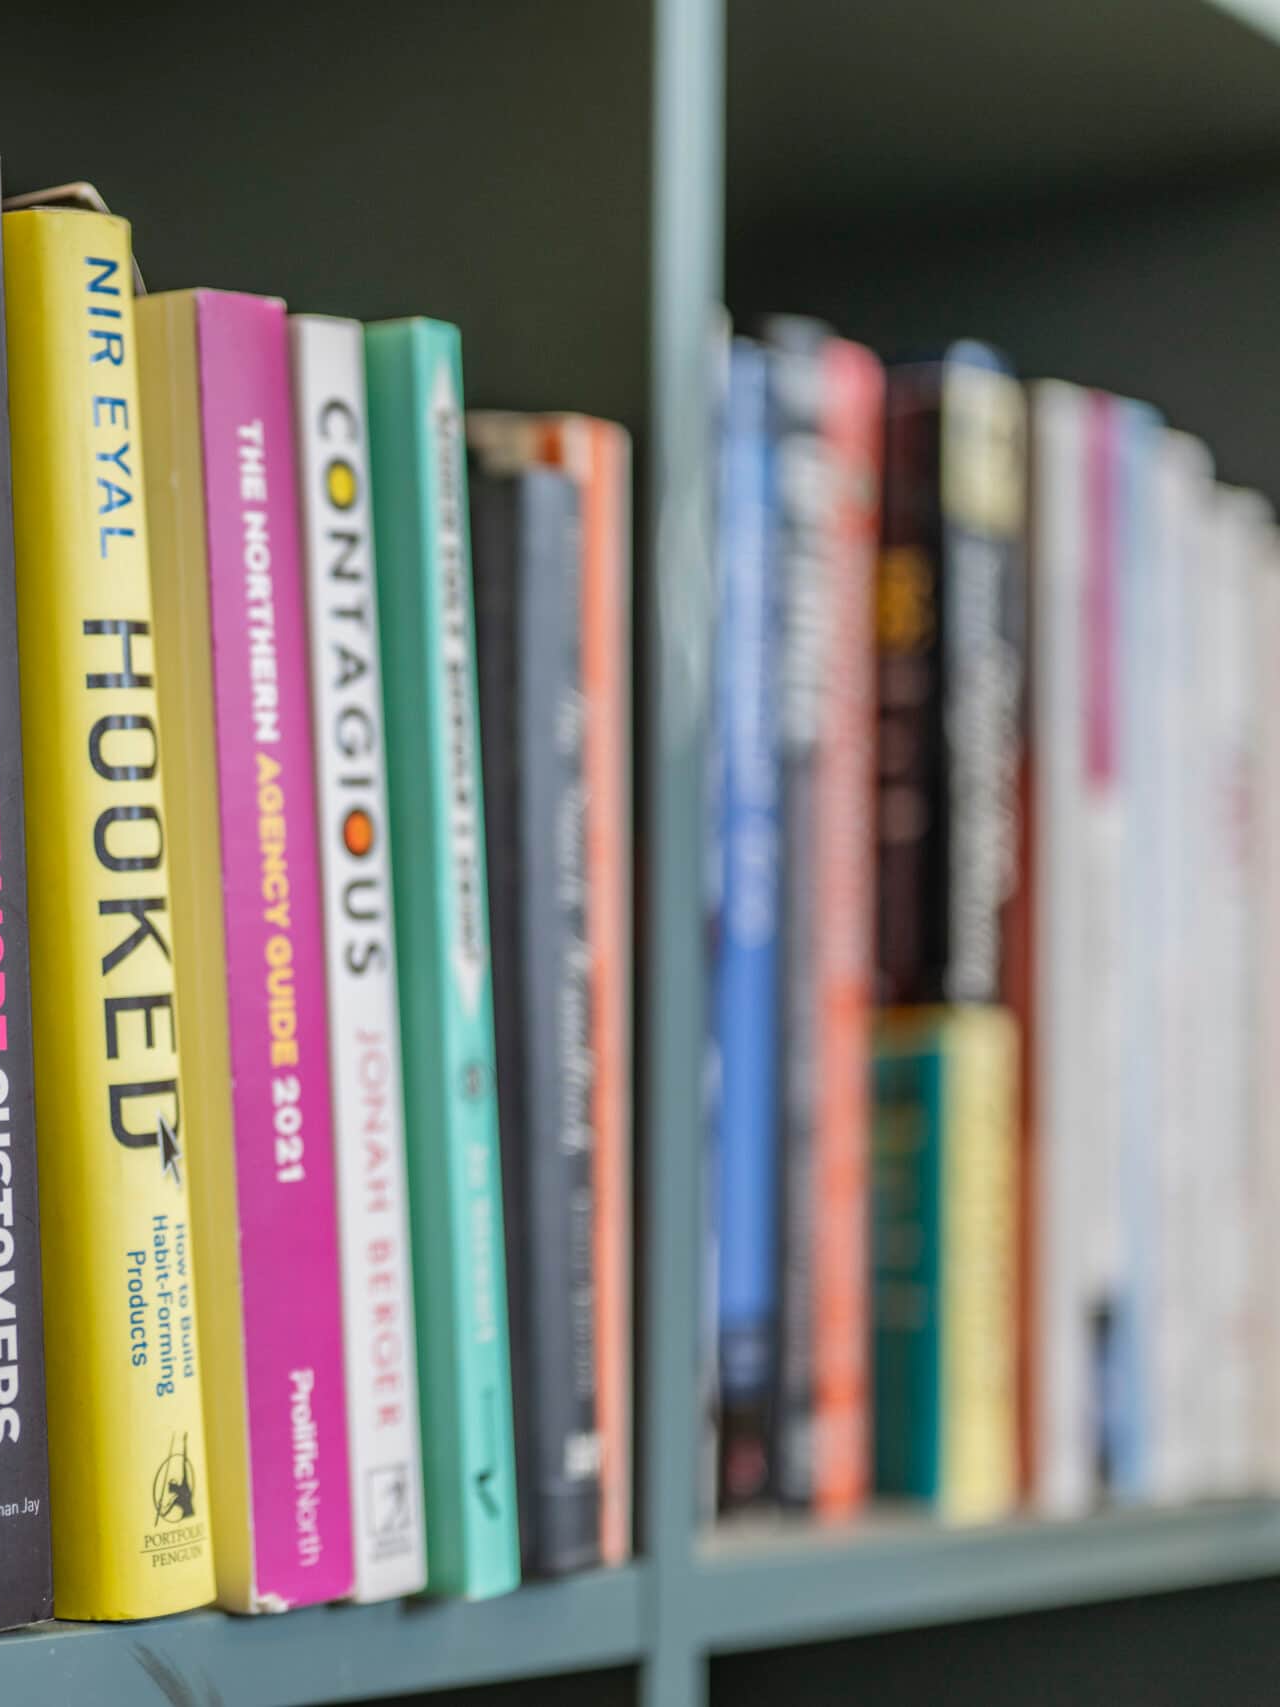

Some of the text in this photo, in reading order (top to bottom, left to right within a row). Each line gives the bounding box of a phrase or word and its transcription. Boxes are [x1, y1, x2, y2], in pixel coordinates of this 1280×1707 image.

[84, 256, 135, 560] NIR EYAL
[238, 419, 305, 1183] THE NORTHERN AGENCY GUIDE 2021
[320, 402, 384, 976] CONTAGIOUS
[83, 619, 181, 1150] HOOKED
[126, 1250, 149, 1367] Products
[152, 1215, 176, 1398] Habit-Forming
[175, 1223, 194, 1379] How to Build
[355, 1026, 402, 1430] JONAH BERGER
[22, 1496, 41, 1516] Jay
[151, 1545, 203, 1568] PENGUIN
